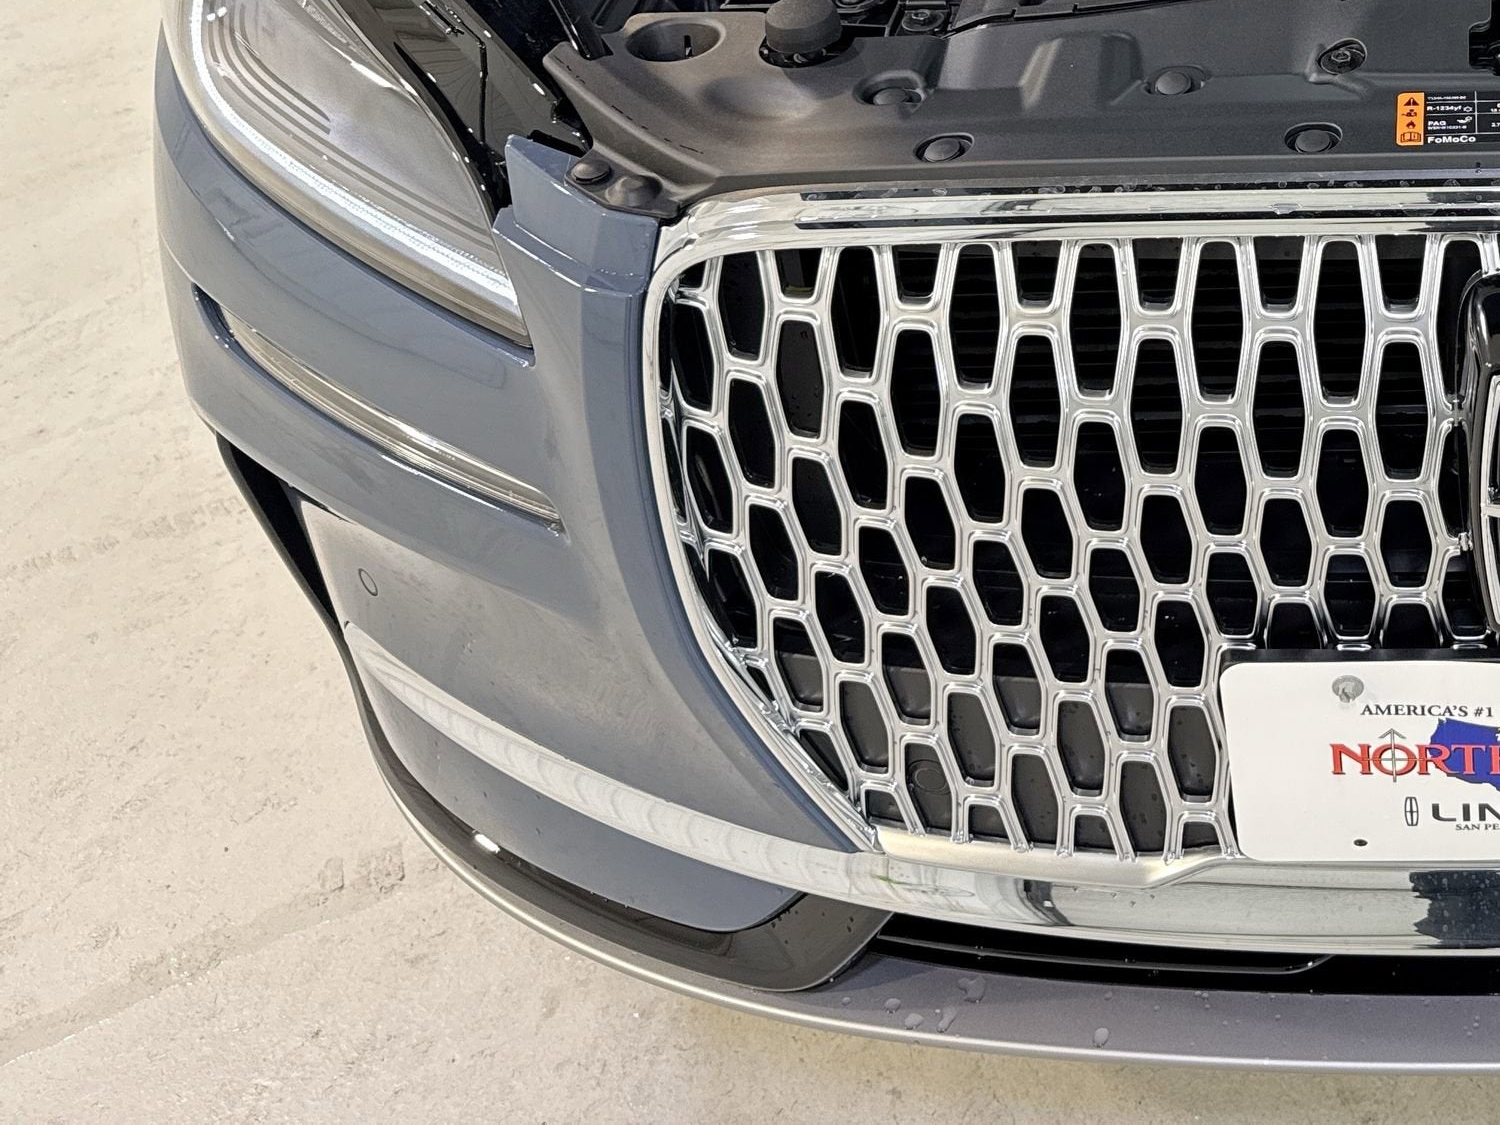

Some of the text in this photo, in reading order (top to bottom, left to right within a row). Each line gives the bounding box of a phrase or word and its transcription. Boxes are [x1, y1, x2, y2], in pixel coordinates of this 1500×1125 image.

[1427, 135, 1476, 144] FoMoCo
[1360, 704, 1468, 717] AMERICA'S
[1474, 706, 1494, 718] #1
[1456, 823, 1480, 831] SAN
